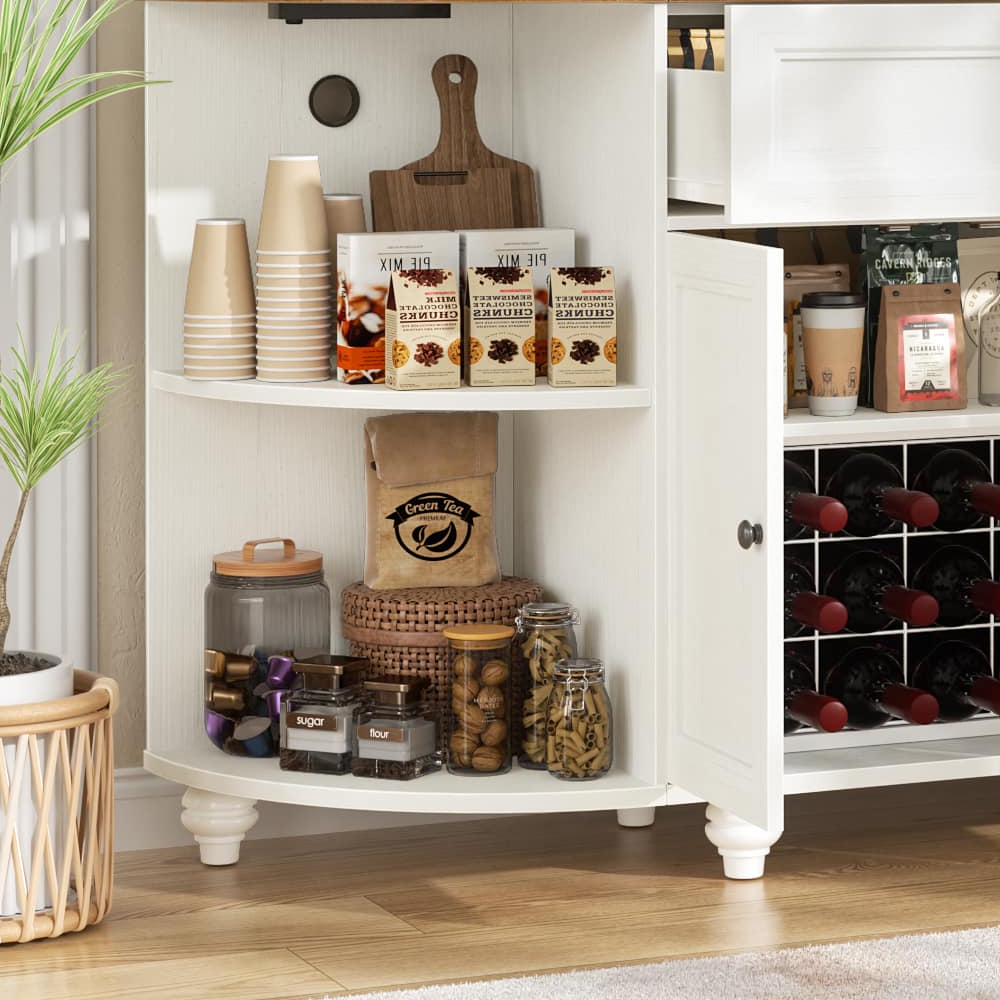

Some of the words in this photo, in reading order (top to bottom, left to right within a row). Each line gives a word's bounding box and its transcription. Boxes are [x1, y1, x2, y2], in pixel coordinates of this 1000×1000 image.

[874, 258, 913, 270] CAVERN
[404, 502, 439, 516] Green
[443, 499, 465, 514] Tea
[296, 716, 326, 728] sugar
[369, 728, 390, 739] flour
